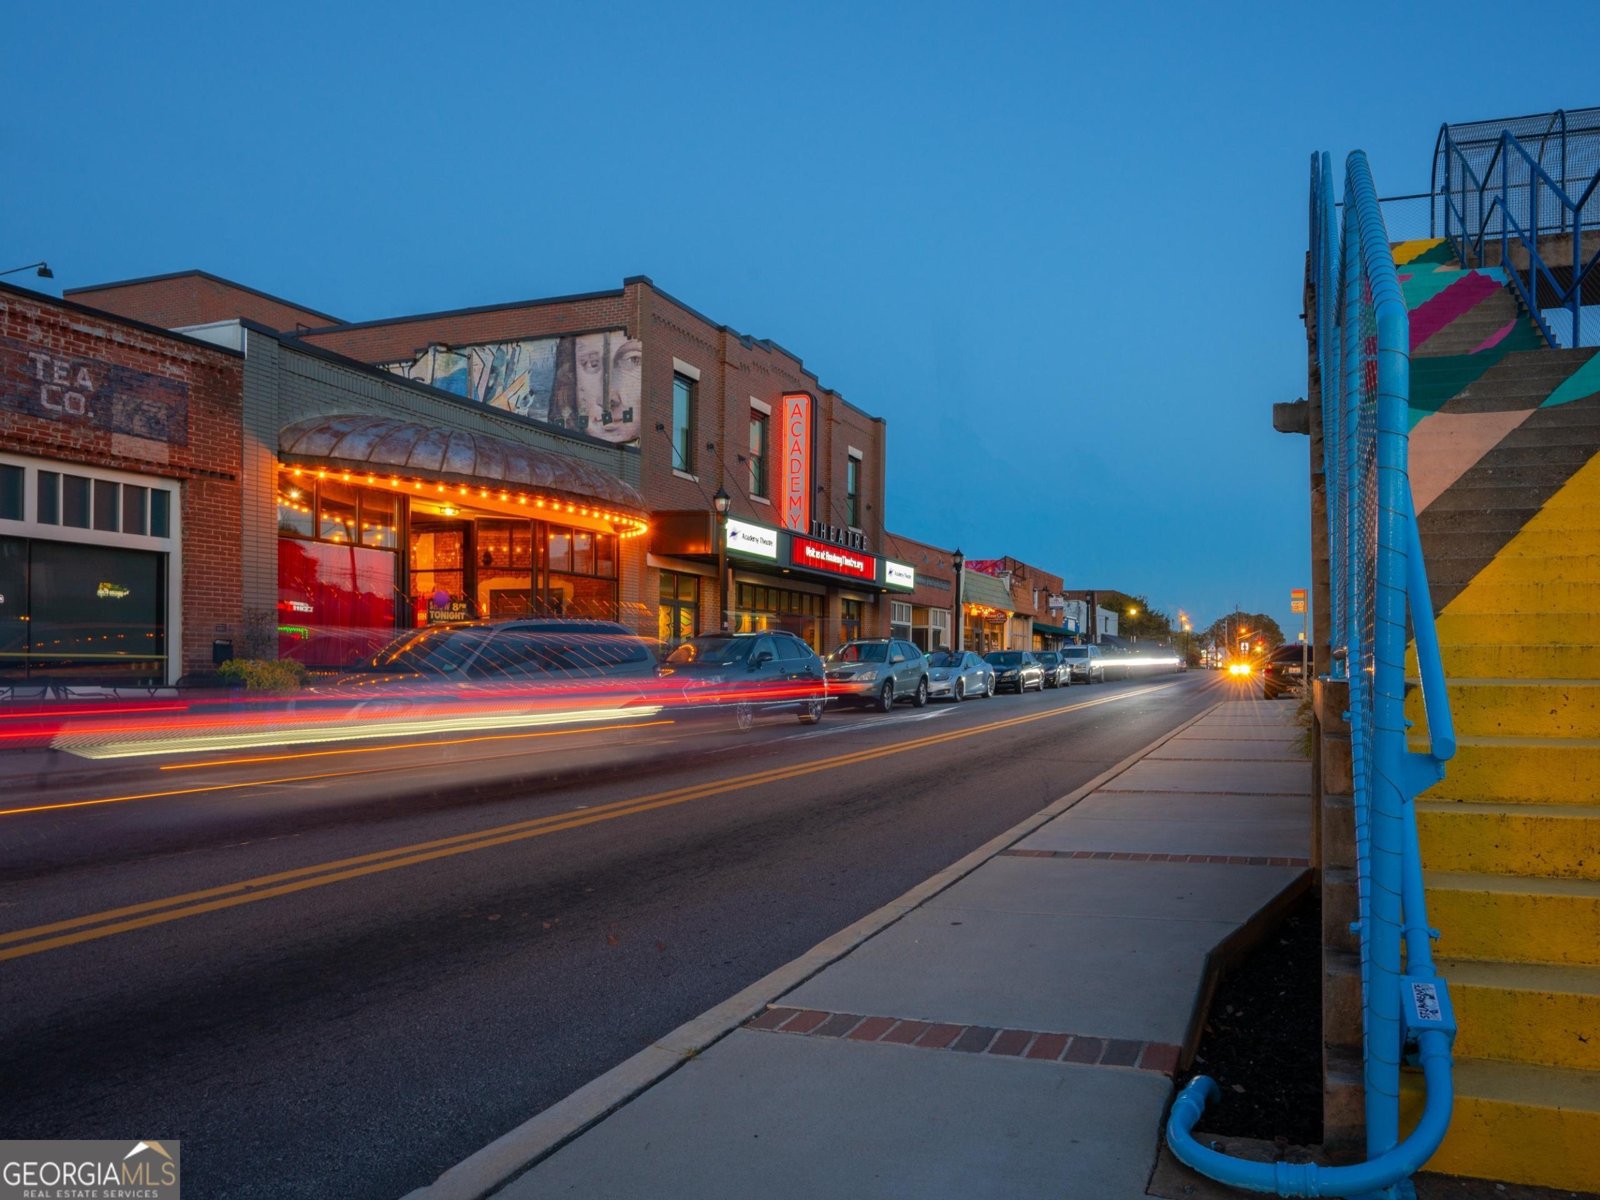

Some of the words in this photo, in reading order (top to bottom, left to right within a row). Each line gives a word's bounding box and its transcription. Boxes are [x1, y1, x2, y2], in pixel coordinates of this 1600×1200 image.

[28, 351, 94, 392] TEA
[40, 384, 94, 418] CO.
[789, 403, 803, 528] ACADEMY
[811, 520, 868, 551] THEATRE
[430, 611, 465, 620] TONIGHT
